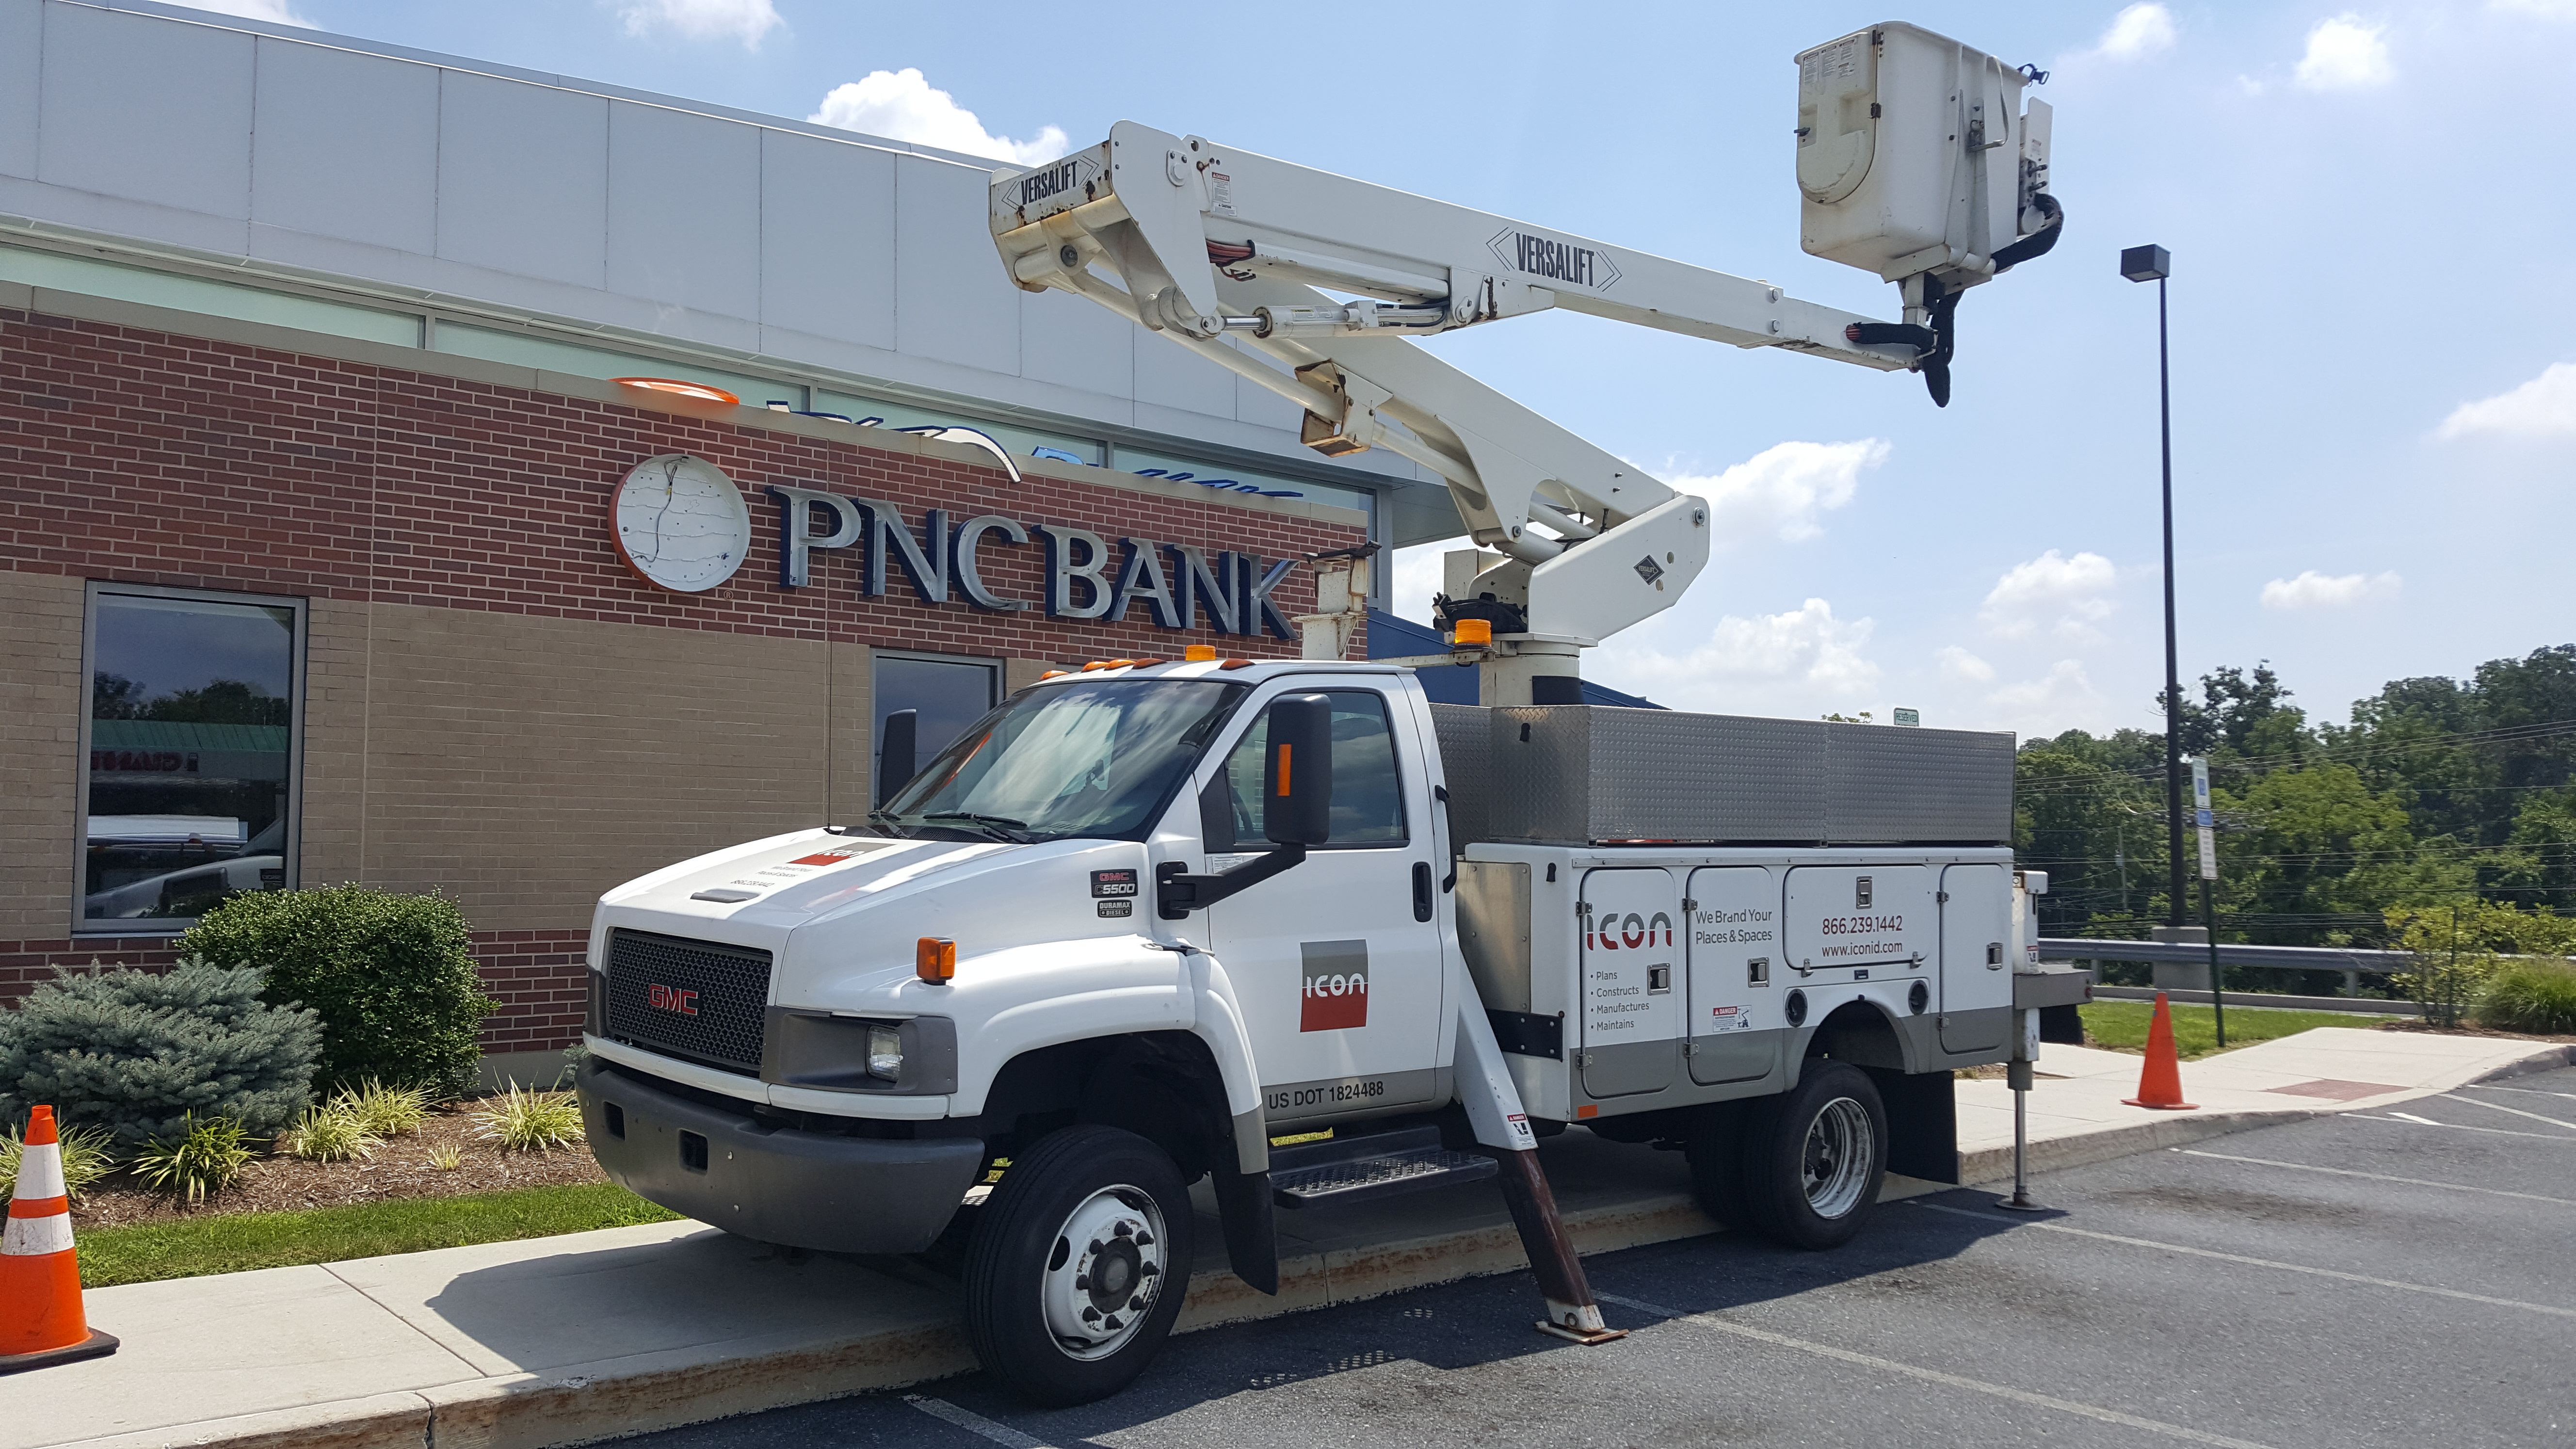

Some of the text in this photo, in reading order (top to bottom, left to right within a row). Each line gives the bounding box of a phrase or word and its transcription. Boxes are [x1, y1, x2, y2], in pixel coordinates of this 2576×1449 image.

[1021, 160, 1078, 206] VERSALIFT
[1516, 232, 1594, 287] VERSALIFT
[764, 484, 1301, 641] PNC BANK
[1638, 565, 1655, 573] VERSALIFT
[1896, 713, 1917, 722] RESERVED
[1099, 872, 1129, 881] GMC
[1095, 883, 1135, 895] C5500
[1695, 909, 1772, 924] We Brand Your
[1822, 915, 1902, 934] 866.239.1442
[1696, 929, 1772, 945] Places & Spaces
[1822, 940, 1902, 957] www.iconid.com
[1596, 971, 1617, 981] Plans
[649, 982, 698, 1016] GMC
[1596, 986, 1639, 998] Constructs
[1596, 1002, 1649, 1014] Manufactures
[1596, 1019, 1634, 1031] Maintains
[1269, 1081, 1384, 1110] US DOT 1824488
